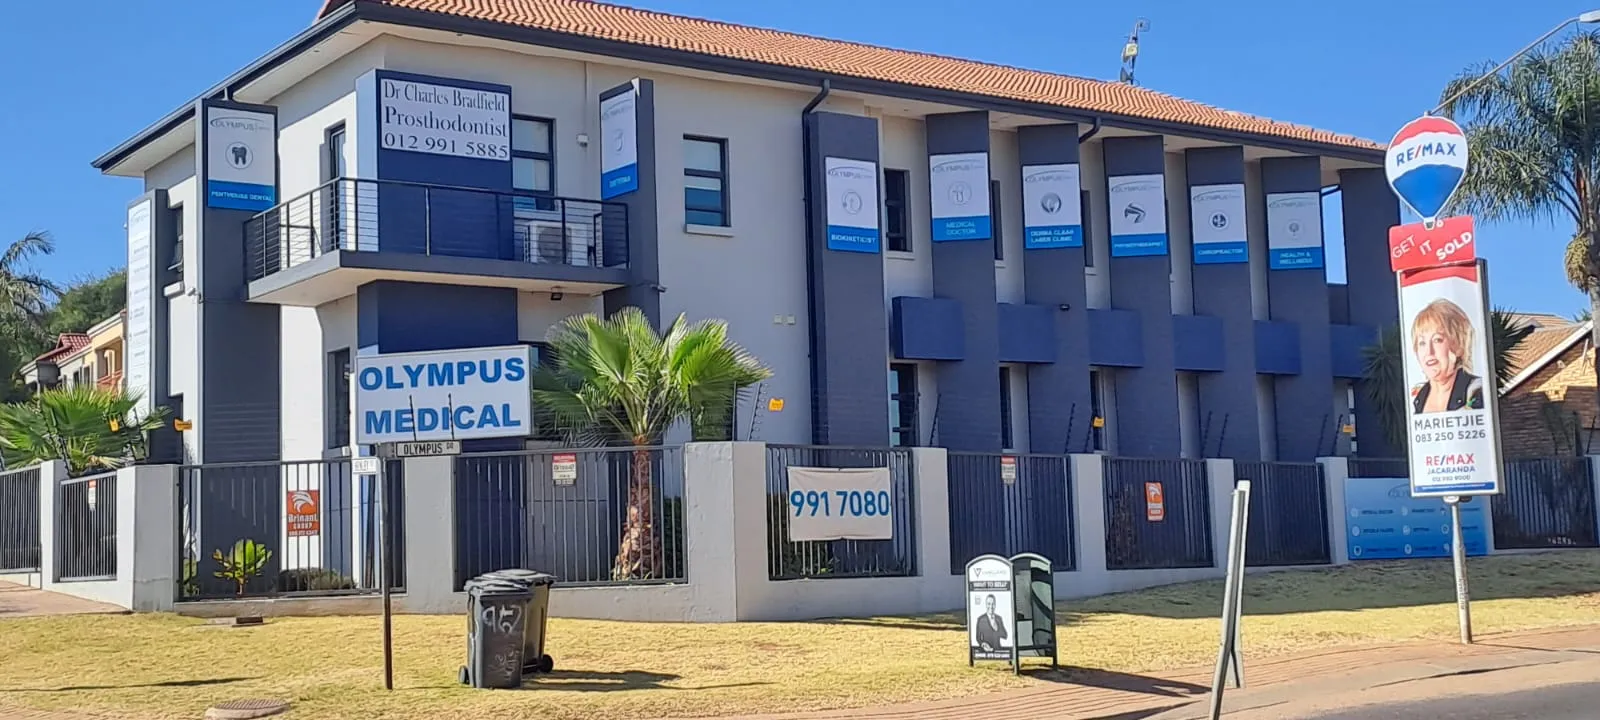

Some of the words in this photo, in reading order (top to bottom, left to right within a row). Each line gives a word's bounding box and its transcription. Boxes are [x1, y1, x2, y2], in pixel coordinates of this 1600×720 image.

[384, 81, 401, 100] Dr
[404, 83, 449, 106] Charles
[453, 89, 506, 112] Bradfield
[384, 106, 508, 138] Prosthodontist
[384, 133, 419, 149] 012
[425, 137, 457, 153] 991
[465, 142, 509, 159] 5885
[1396, 142, 1457, 167] RE/MAX
[249, 194, 273, 202] DENTAL
[1391, 234, 1417, 259] GET
[1419, 240, 1433, 257] IT
[1435, 231, 1474, 261] SOLD
[359, 356, 526, 391] OLYMPUS
[365, 403, 522, 434] MEDICAL
[1414, 414, 1485, 431] MARIETJIE
[1415, 432, 1433, 443] 083
[1434, 431, 1455, 442] 250
[1458, 429, 1487, 440] 5226
[403, 443, 443, 456] OLYMPUS
[1426, 453, 1475, 466] RE/MAX
[1427, 465, 1477, 475] JACARANDA
[790, 490, 830, 517] 991
[835, 490, 889, 517] 7080
